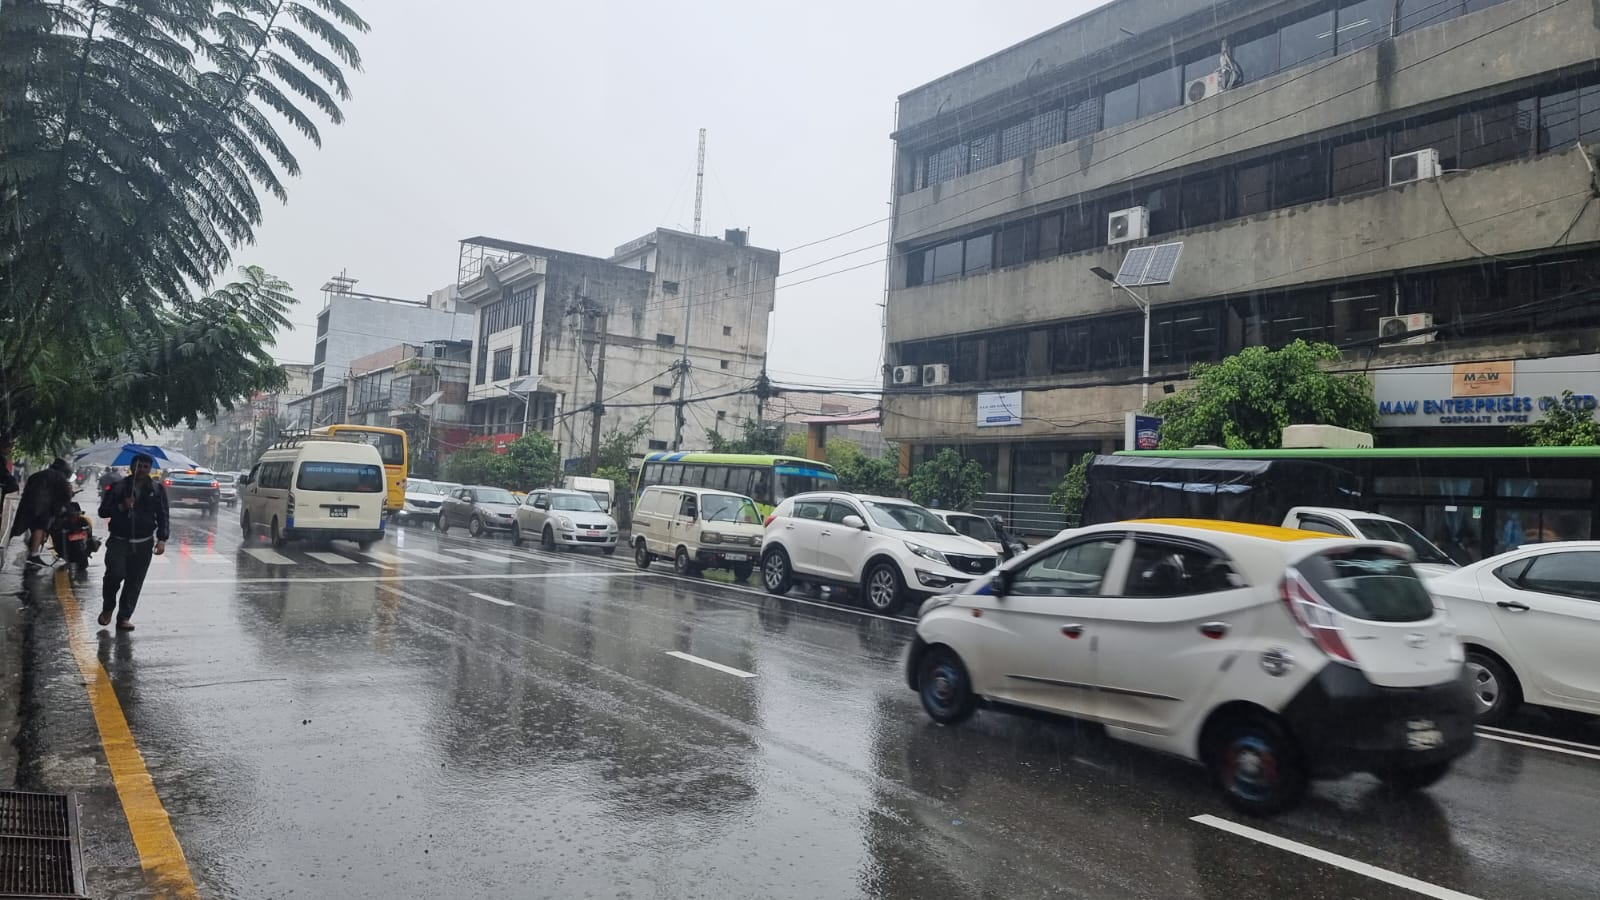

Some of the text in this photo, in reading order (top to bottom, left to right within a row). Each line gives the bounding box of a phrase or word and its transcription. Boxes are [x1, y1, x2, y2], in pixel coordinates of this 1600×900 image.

[1464, 372, 1500, 381] MAW
[1379, 400, 1418, 415] MAW
[1423, 396, 1532, 414] ENTERPRISES
[1440, 414, 1528, 424] CORPORATE OFFICE
